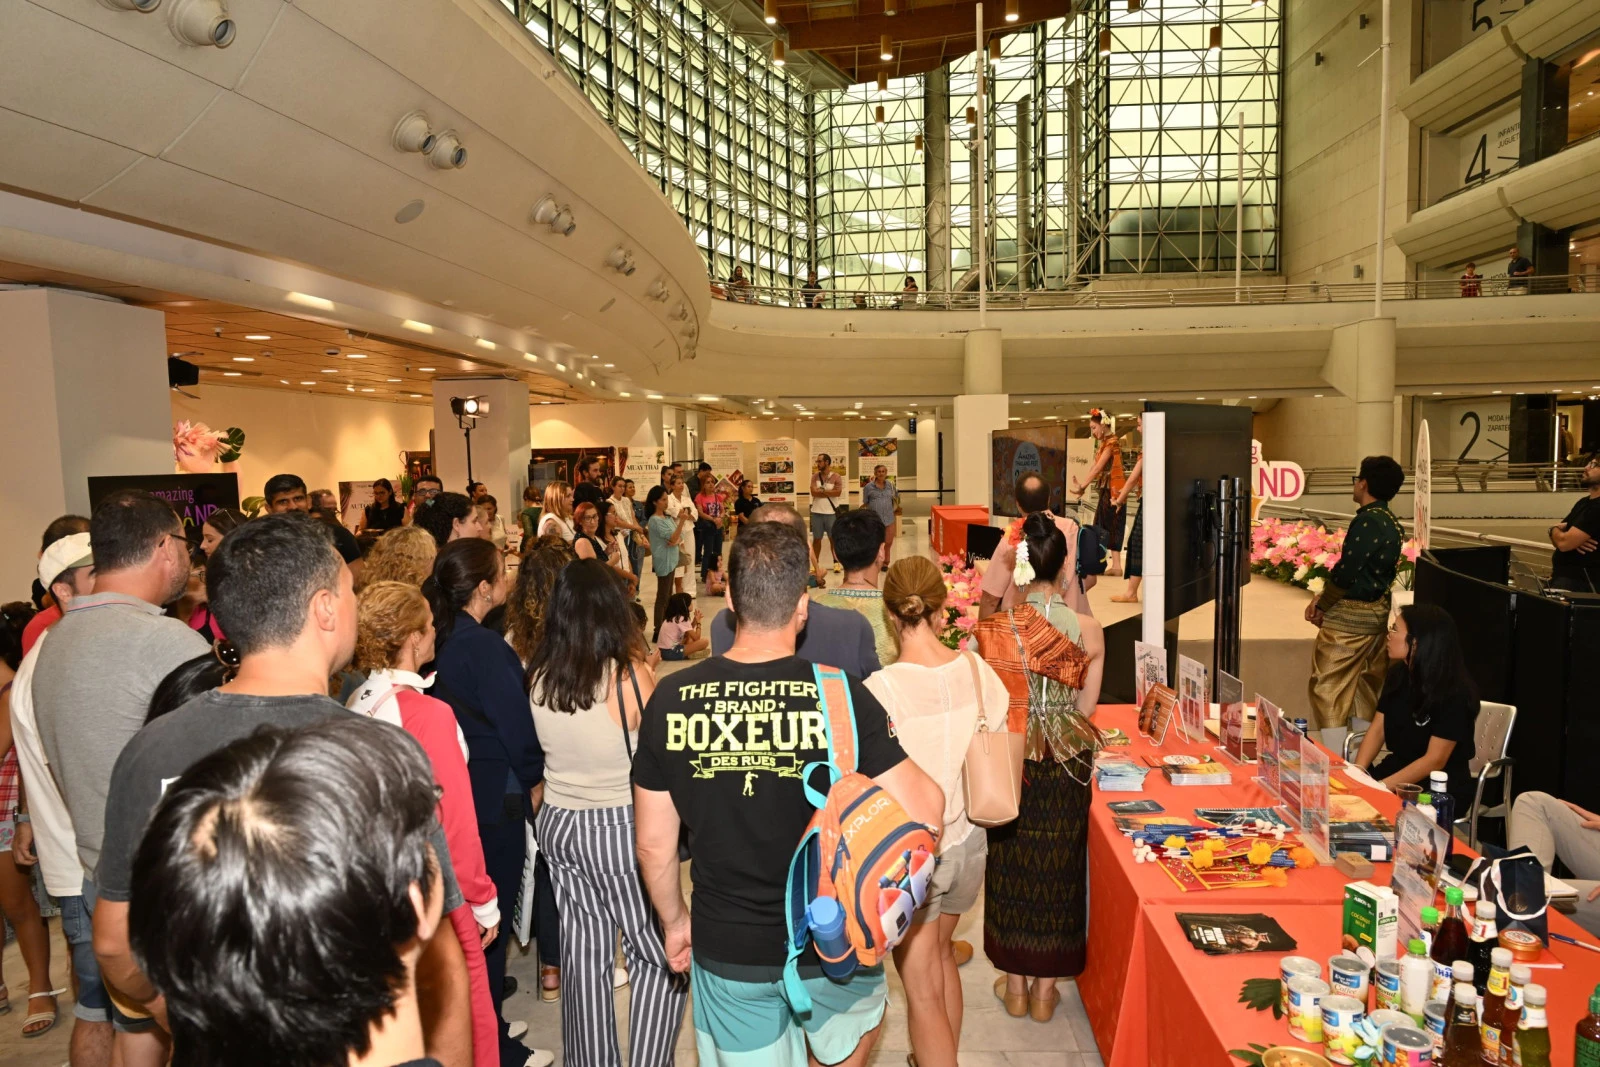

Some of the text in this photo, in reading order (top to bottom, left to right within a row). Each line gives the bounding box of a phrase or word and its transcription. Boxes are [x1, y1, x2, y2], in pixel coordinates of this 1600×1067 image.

[1465, 133, 1490, 184] 4
[1487, 414, 1504, 422] MODA
[1458, 411, 1480, 463] 2
[679, 680, 819, 701] THE FIGHTER
[714, 699, 777, 713] BRAND
[666, 711, 829, 752] BOXEUR
[711, 756, 776, 768] DES RUES
[1480, 924, 1487, 938] 1
[1334, 983, 1357, 994] Coffee
[1502, 976, 1508, 991] 1
